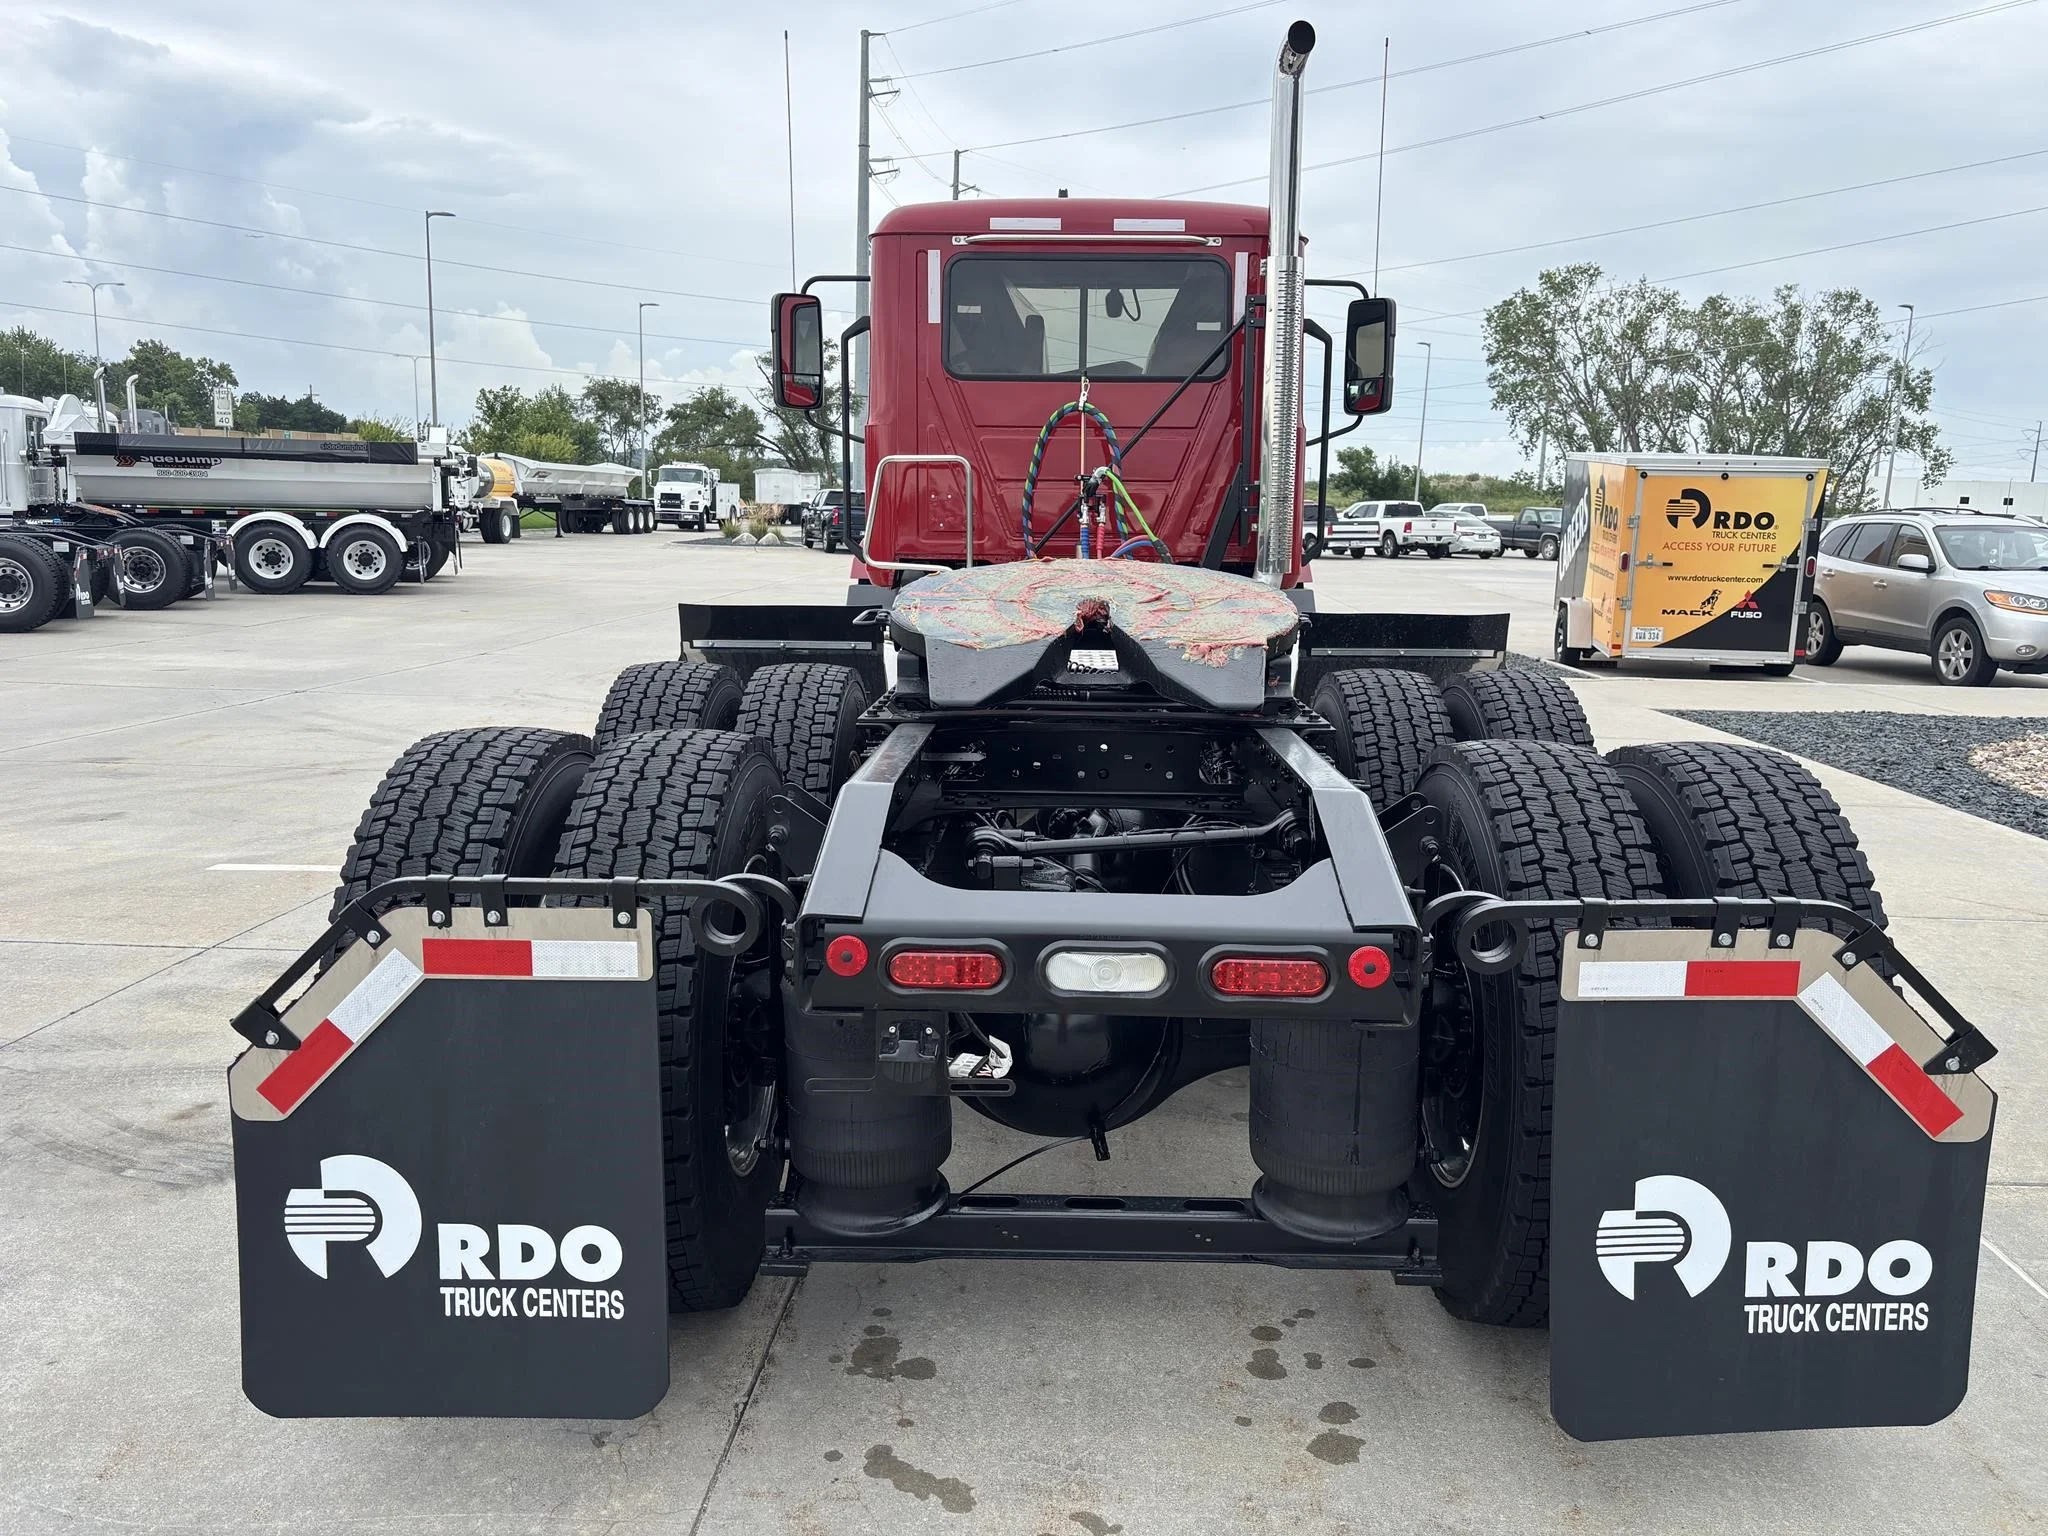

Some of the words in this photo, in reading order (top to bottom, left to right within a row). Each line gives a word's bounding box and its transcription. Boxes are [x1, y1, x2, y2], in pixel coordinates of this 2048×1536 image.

[1713, 511, 1775, 530] RDO
[1559, 487, 1588, 581] CAREERS
[1712, 531, 1737, 539] TRUCK
[1740, 531, 1777, 540] CENTERS
[1662, 542, 1702, 551] ACCESS
[1706, 542, 1735, 551] YOUR
[1738, 543, 1777, 552] FUTURE
[1667, 575, 1763, 583] www.rdotruckcenter.com
[1730, 611, 1762, 619] FUSO
[437, 1223, 623, 1282] RDO
[1744, 1239, 1933, 1297] RDO
[439, 1287, 519, 1317] TRUCK
[521, 1287, 625, 1320] CENTERS
[1744, 1303, 1821, 1334] TRUCK
[1825, 1302, 1930, 1332] CENTERS
